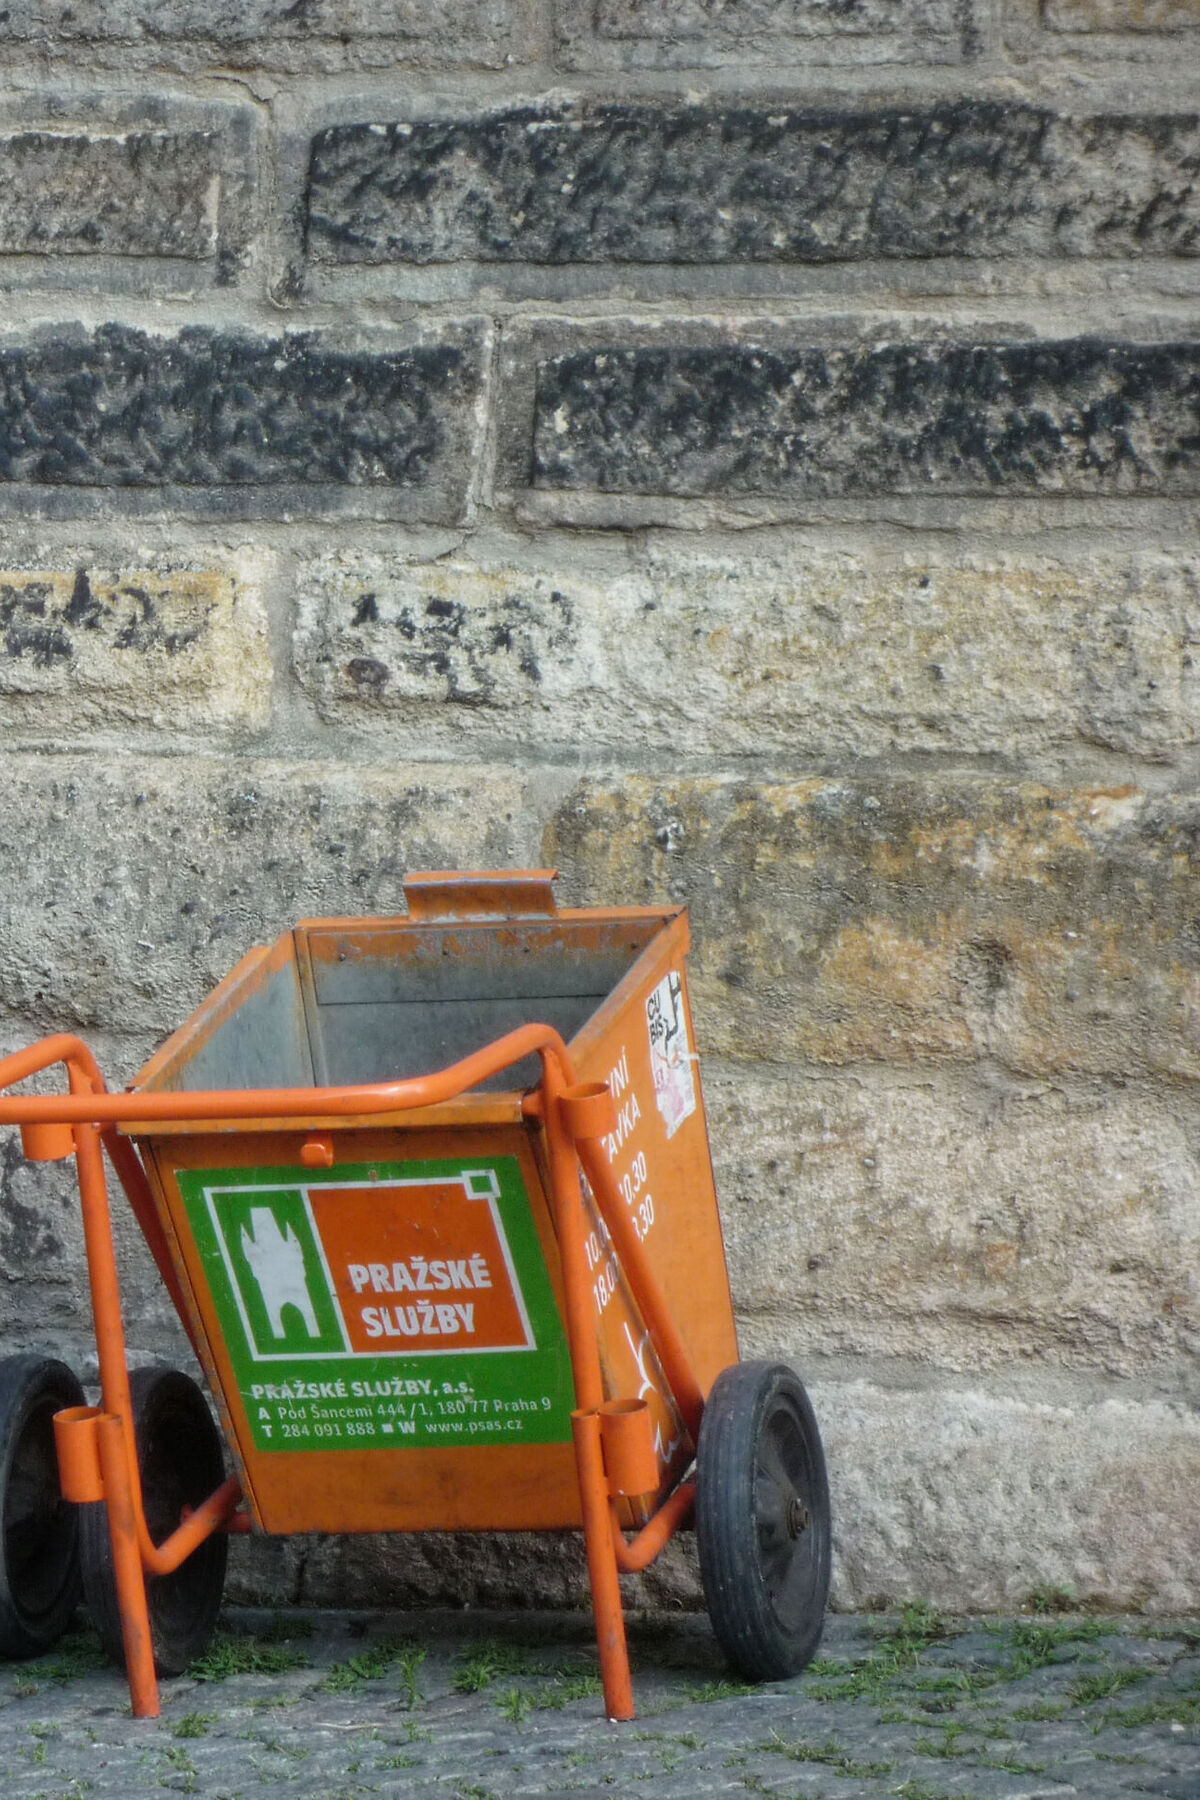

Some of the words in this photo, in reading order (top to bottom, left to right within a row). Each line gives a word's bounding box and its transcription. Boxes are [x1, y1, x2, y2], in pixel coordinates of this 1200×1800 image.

[347, 1253, 493, 1294] PRAŽSKÉ
[361, 1299, 476, 1337] SLUŽBY
[251, 1378, 349, 1400] PRAŽSKÉ
[351, 1376, 437, 1397] SLUŽBY,
[442, 1382, 475, 1395] a.s.
[258, 1407, 271, 1420] A
[278, 1406, 307, 1420] Pod
[310, 1403, 373, 1418] Šancemi
[437, 1400, 466, 1415] 180
[472, 1400, 488, 1413] 77
[493, 1398, 538, 1413] Praha
[541, 1396, 551, 1411] 9
[261, 1425, 273, 1437] T
[281, 1423, 310, 1437] 284
[314, 1423, 342, 1436] 091
[346, 1422, 376, 1436] 888
[398, 1421, 416, 1434] W
[425, 1419, 523, 1434] www.psas.cz
